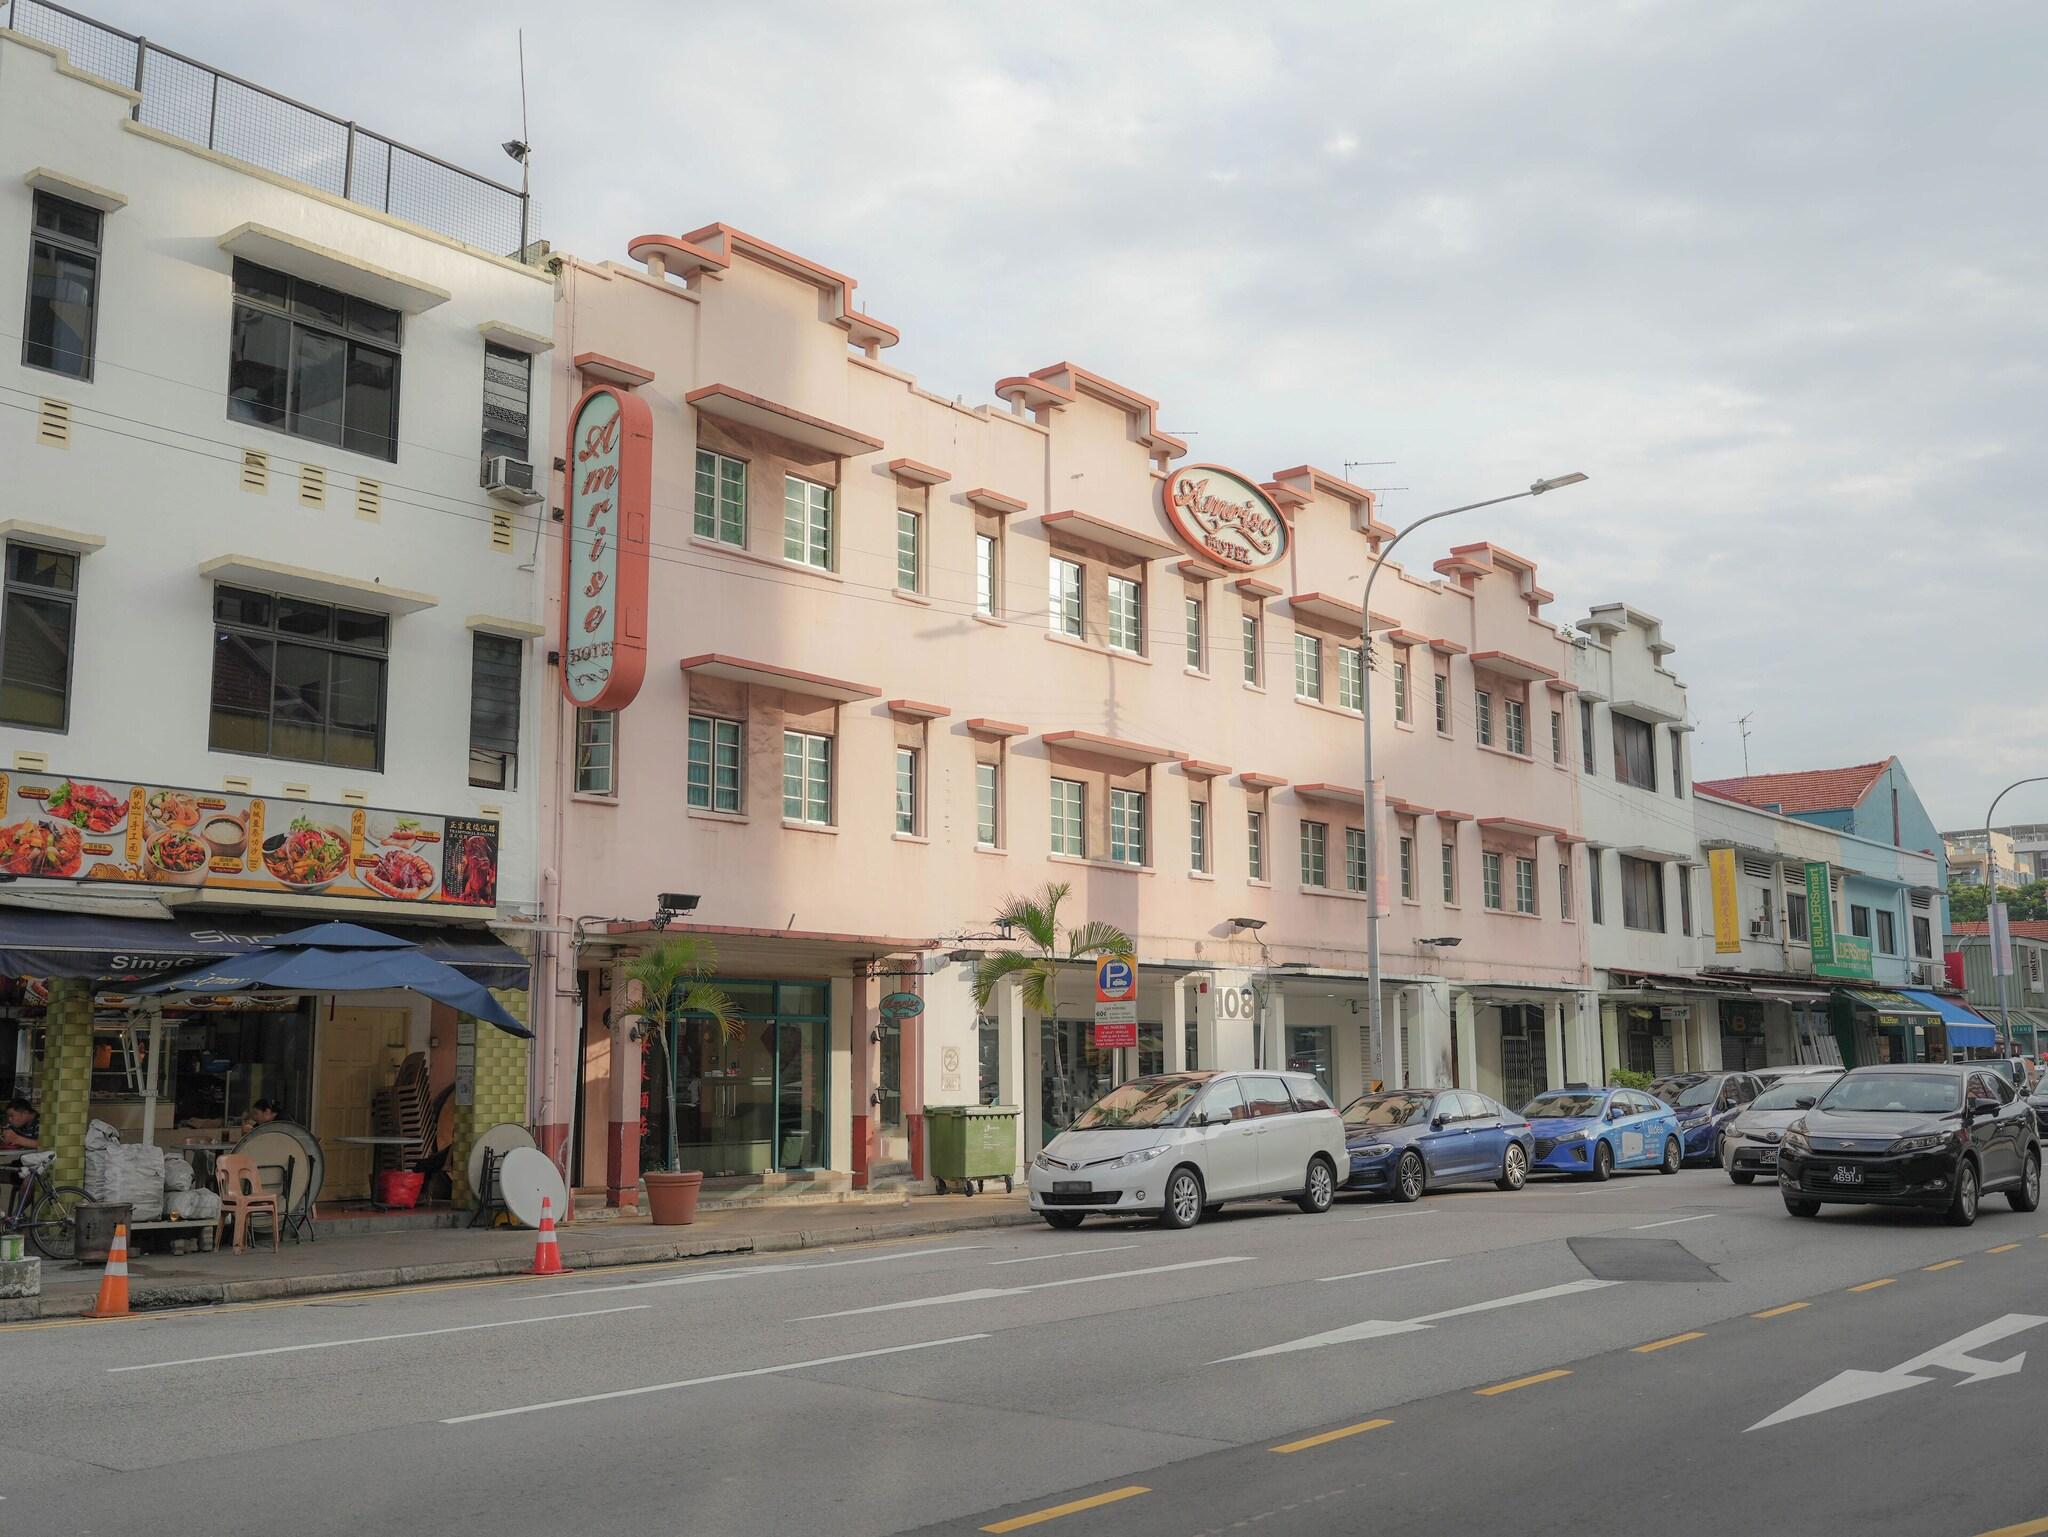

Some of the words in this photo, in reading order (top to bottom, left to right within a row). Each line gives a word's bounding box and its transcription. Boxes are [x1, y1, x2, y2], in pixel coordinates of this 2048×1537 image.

[578, 410, 619, 634] Amrise
[1174, 478, 1279, 538] Amrise
[1204, 534, 1253, 565] HOTEL
[1808, 866, 1825, 948] BUILDERSmart
[2029, 949, 2038, 982] maktec
[1215, 988, 1253, 1018] 108
[2012, 1025, 2033, 1034] ylang
[1833, 1174, 1862, 1183] 4691J
[1837, 1166, 1856, 1174] SLJ
